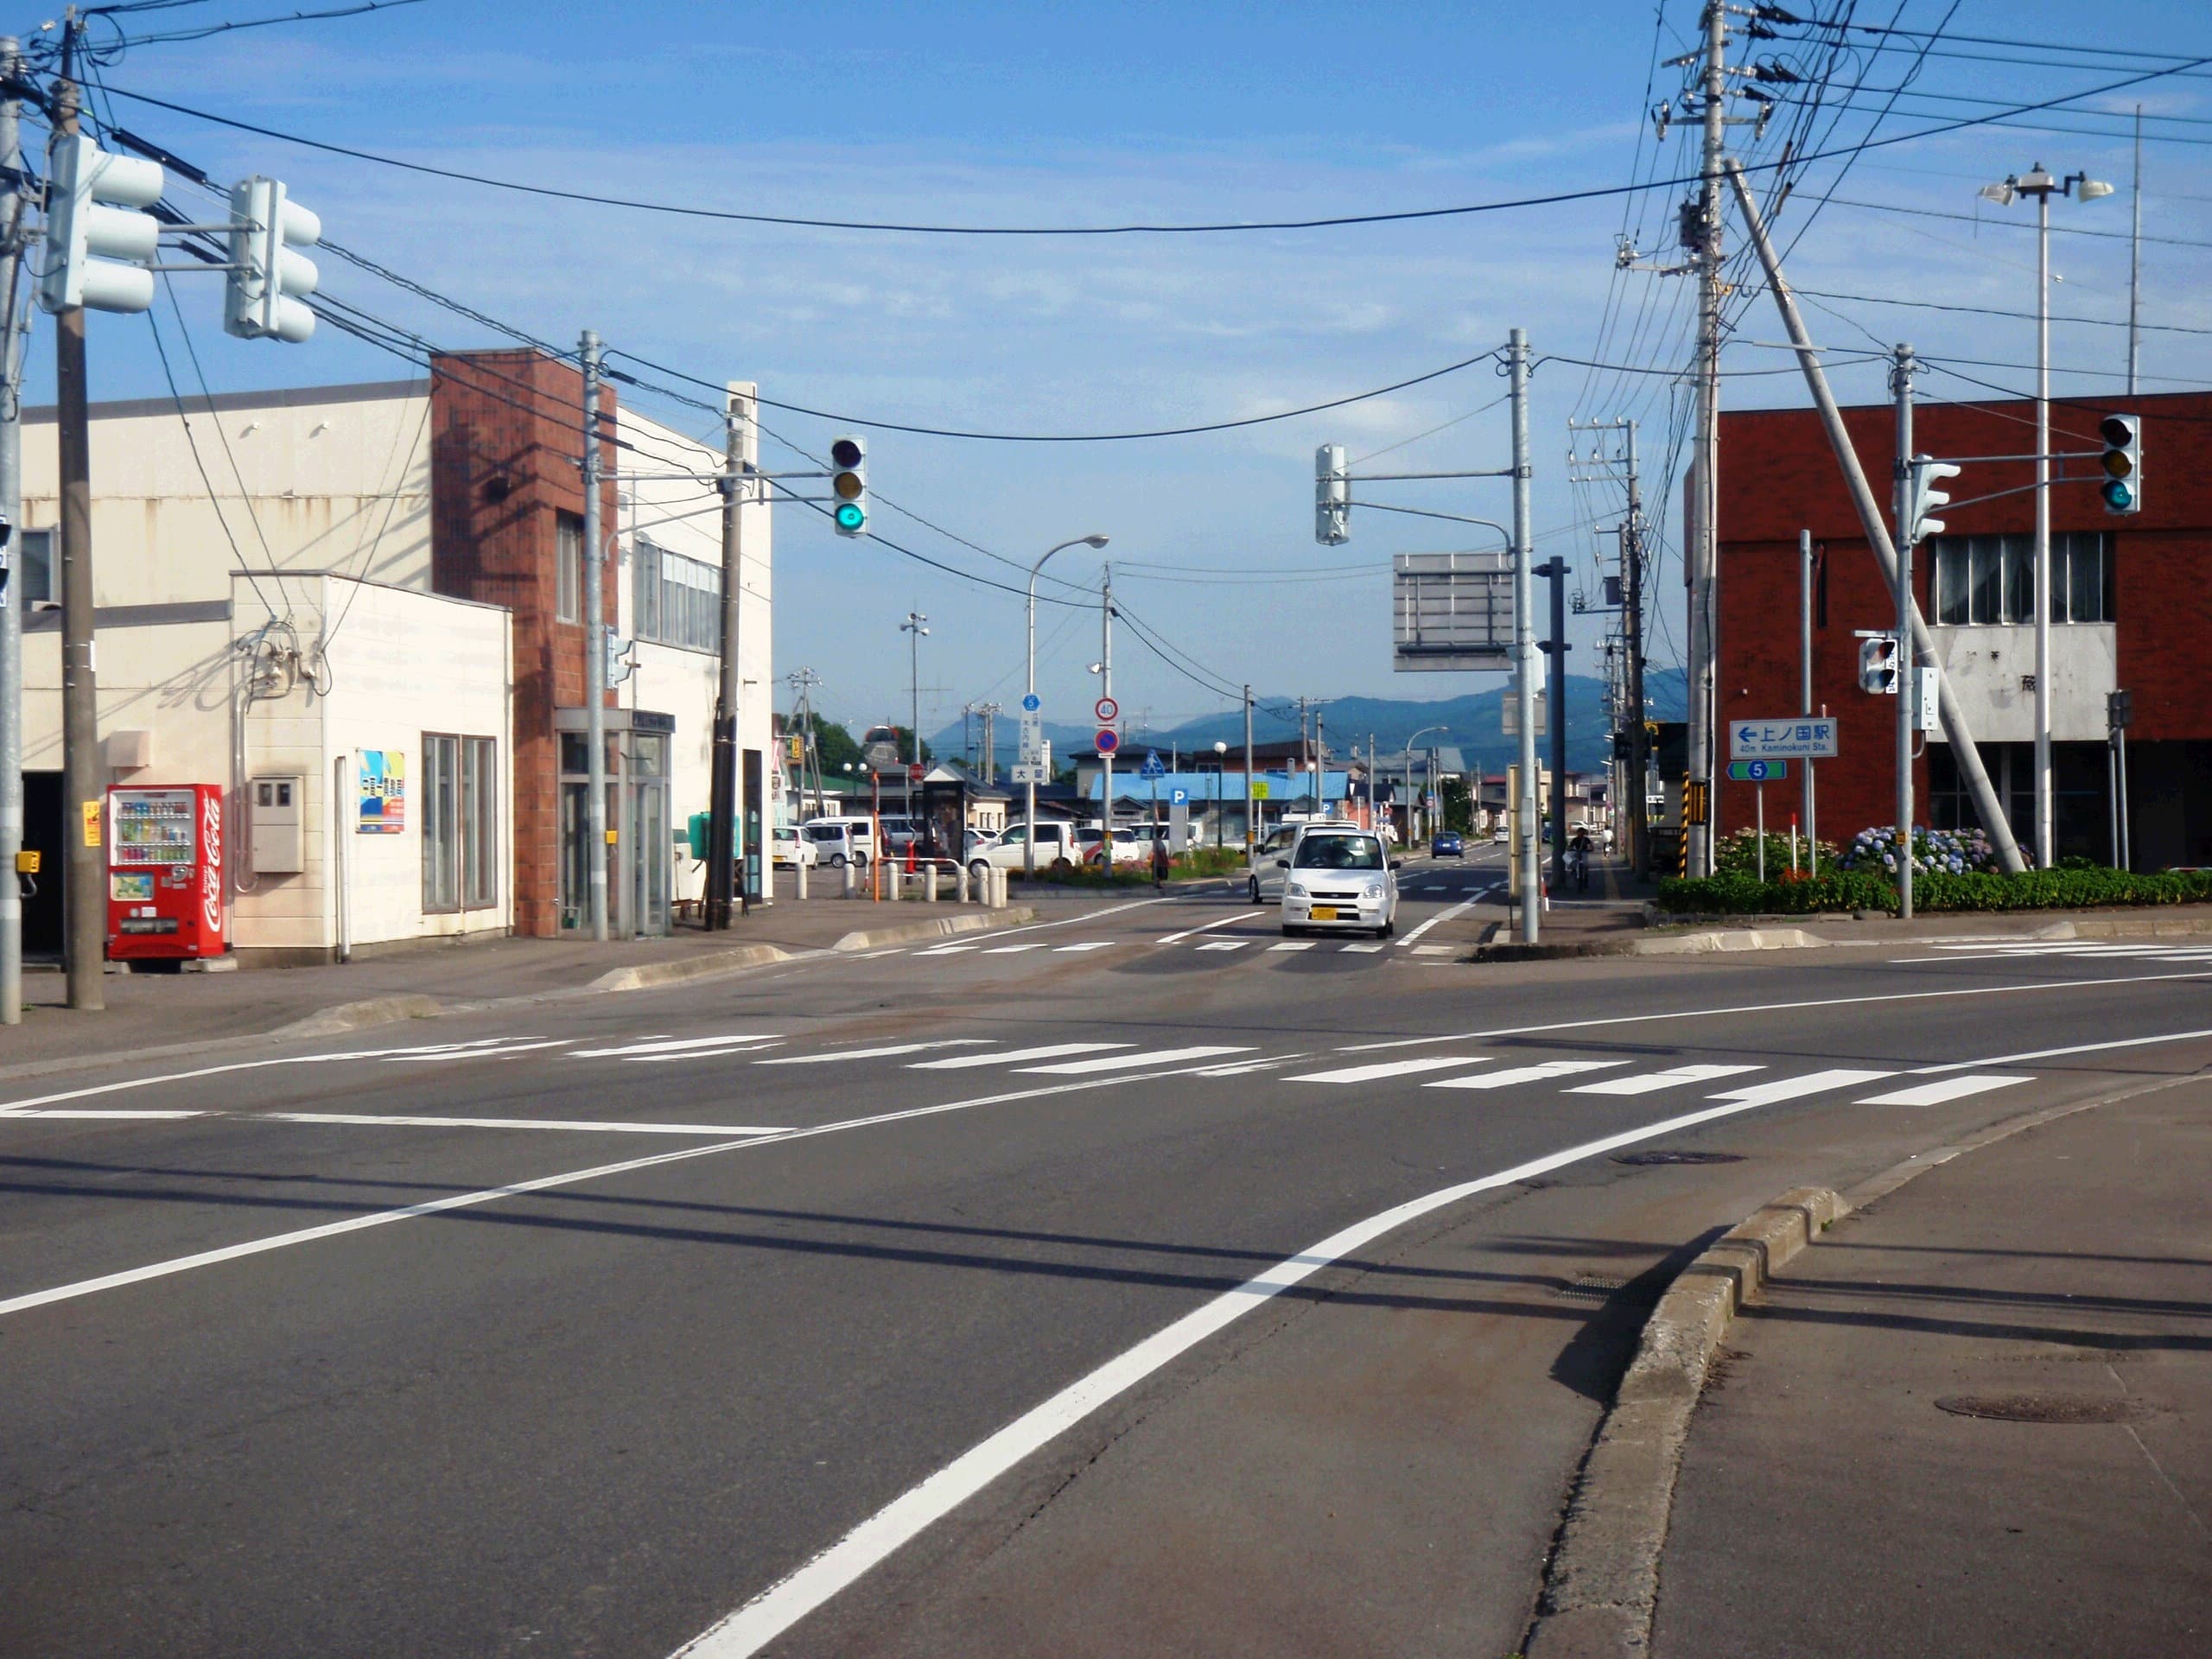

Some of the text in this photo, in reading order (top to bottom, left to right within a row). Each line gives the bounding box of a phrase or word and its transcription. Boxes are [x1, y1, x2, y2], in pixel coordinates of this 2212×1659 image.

[1101, 704, 1114, 714] 40
[1760, 725, 1830, 741] 上ノ国駅
[1762, 742, 1810, 753] Kaminokuni
[1753, 764, 1763, 777] 5
[1174, 790, 1185, 804] P
[1323, 804, 1331, 813] P
